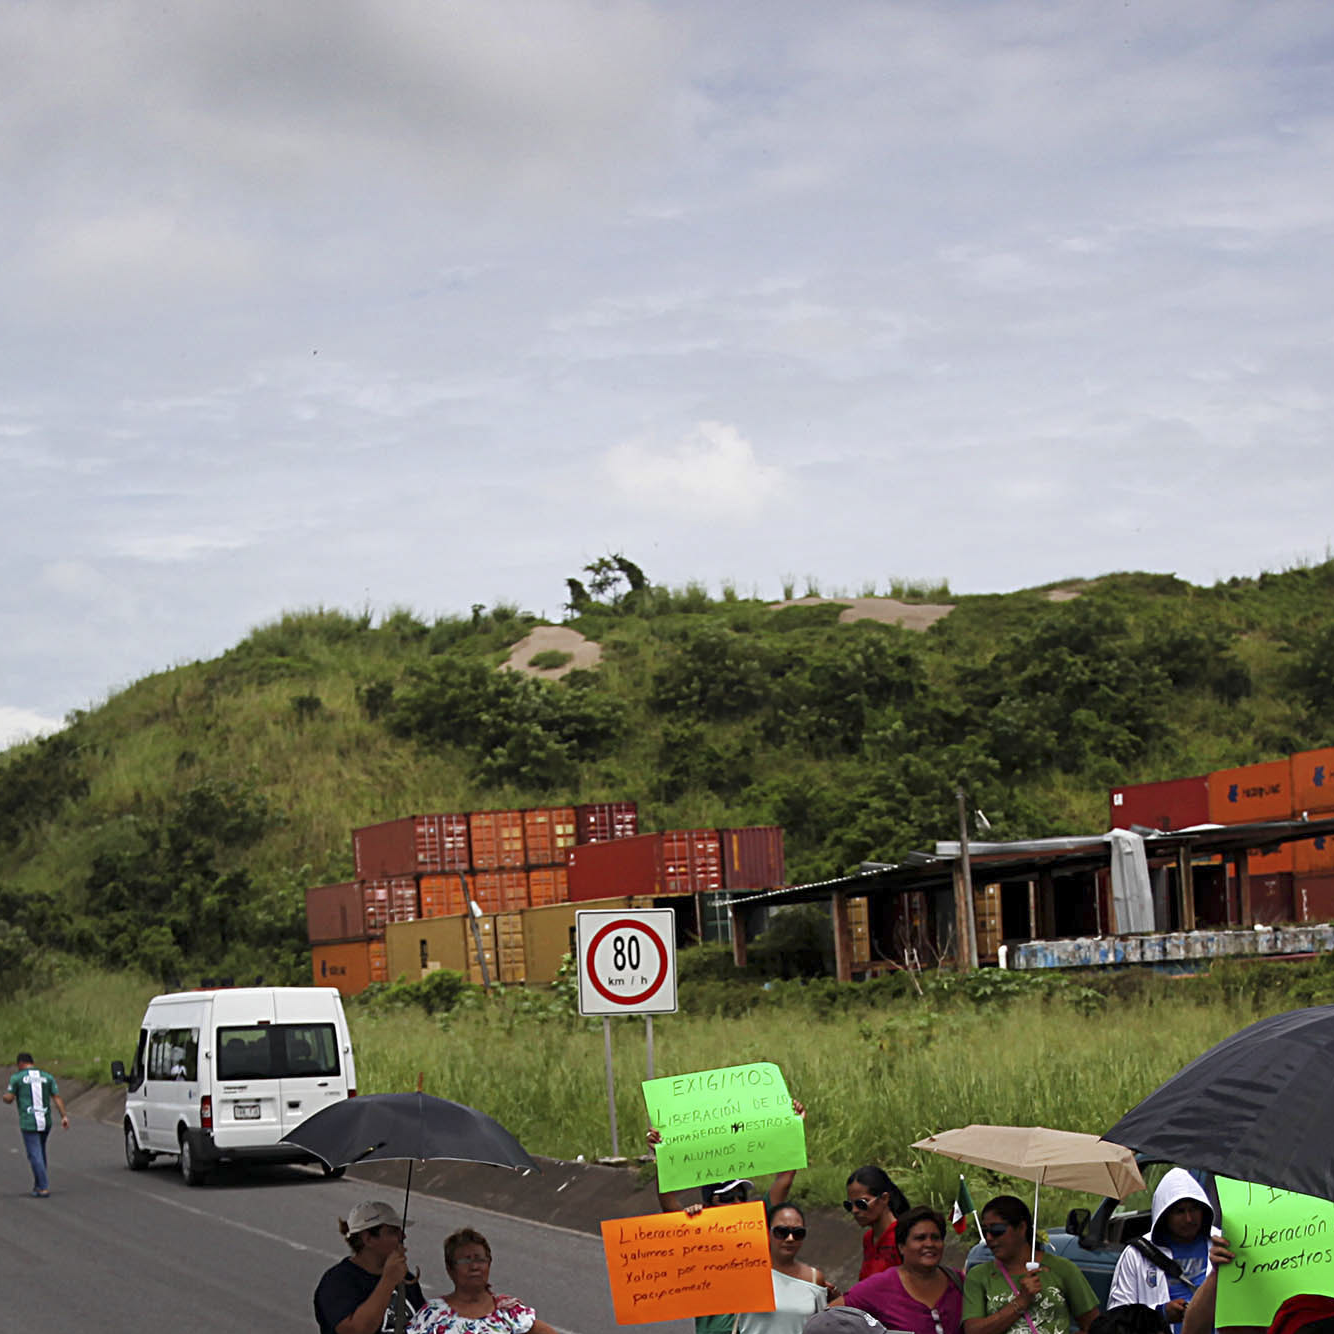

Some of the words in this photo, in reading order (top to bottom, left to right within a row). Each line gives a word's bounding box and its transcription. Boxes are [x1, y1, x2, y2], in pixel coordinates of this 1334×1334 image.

[613, 935, 640, 971] 80
[673, 1067, 774, 1096] EXIGIMOS
[657, 1098, 742, 1129] LIBERACIÓN
[731, 1116, 792, 1134] MAESTROS
[668, 1154, 675, 1167] Y
[683, 1144, 737, 1163] ALUMNOS
[747, 1141, 766, 1153] EN
[695, 1161, 755, 1182] XALAPA
[1239, 1215, 1327, 1249] Liberación
[682, 1243, 724, 1257] presos
[736, 1241, 752, 1249] en
[677, 1264, 696, 1278] por
[1231, 1260, 1246, 1283] y
[1252, 1248, 1332, 1274] maestros
